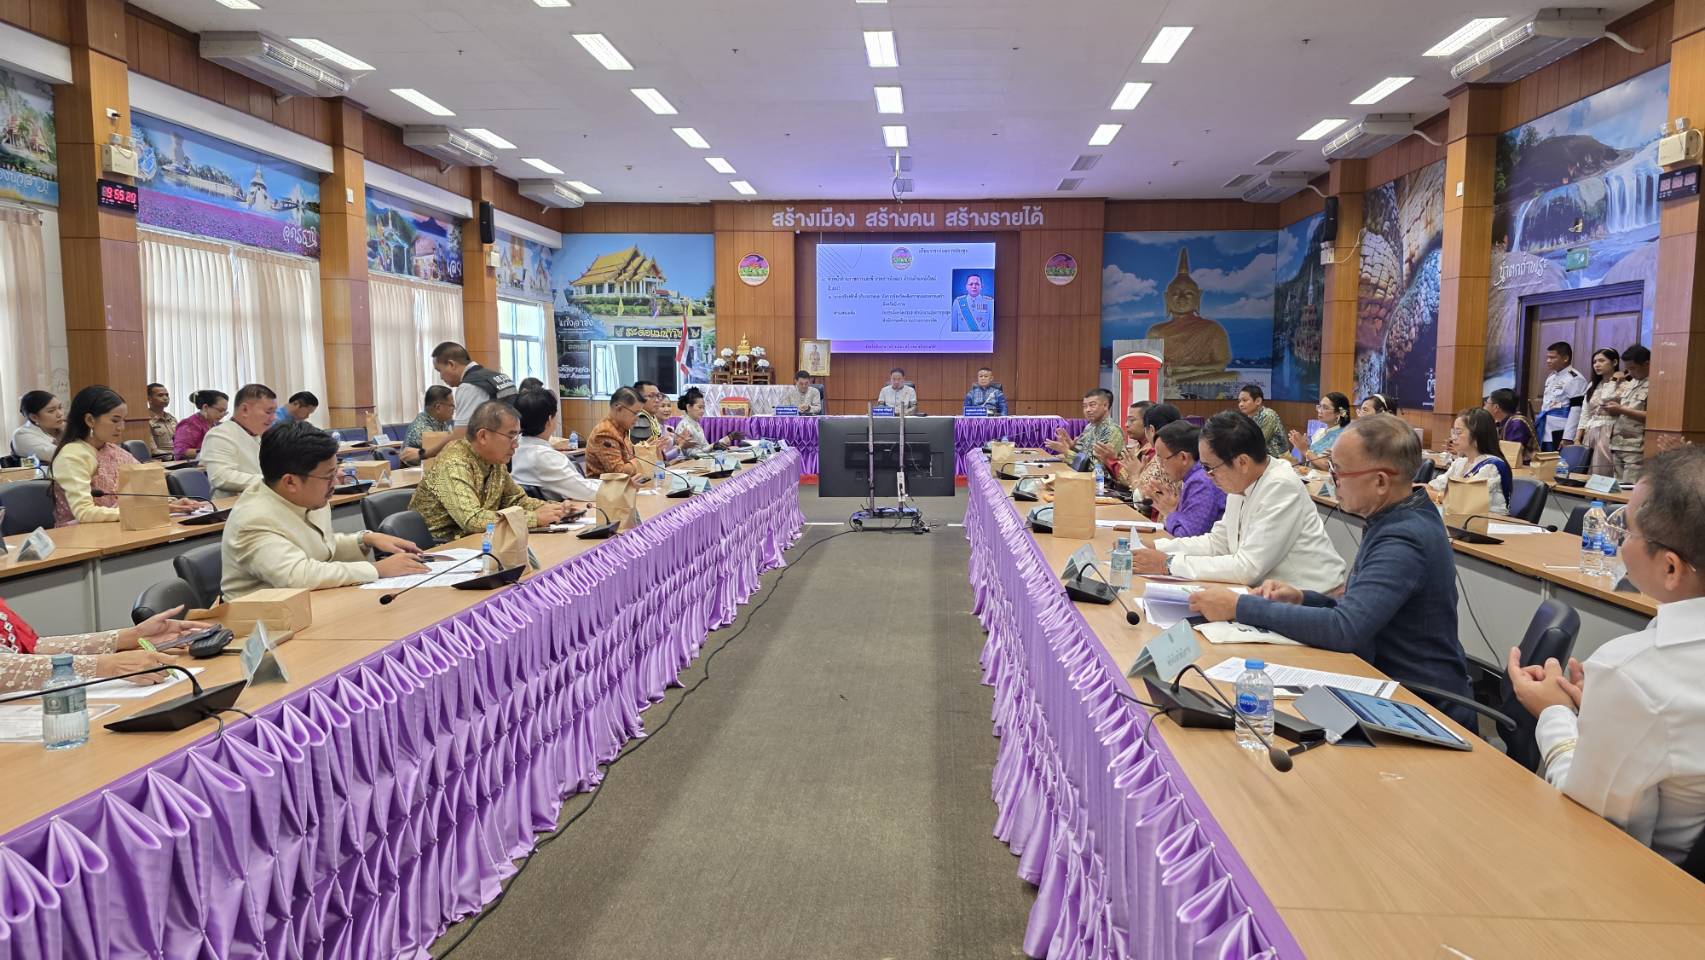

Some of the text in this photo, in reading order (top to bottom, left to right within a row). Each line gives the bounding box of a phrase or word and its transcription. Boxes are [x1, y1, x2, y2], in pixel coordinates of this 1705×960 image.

[772, 205, 1044, 227] สร้างเมือง สร้างคน สร้างรายได้
